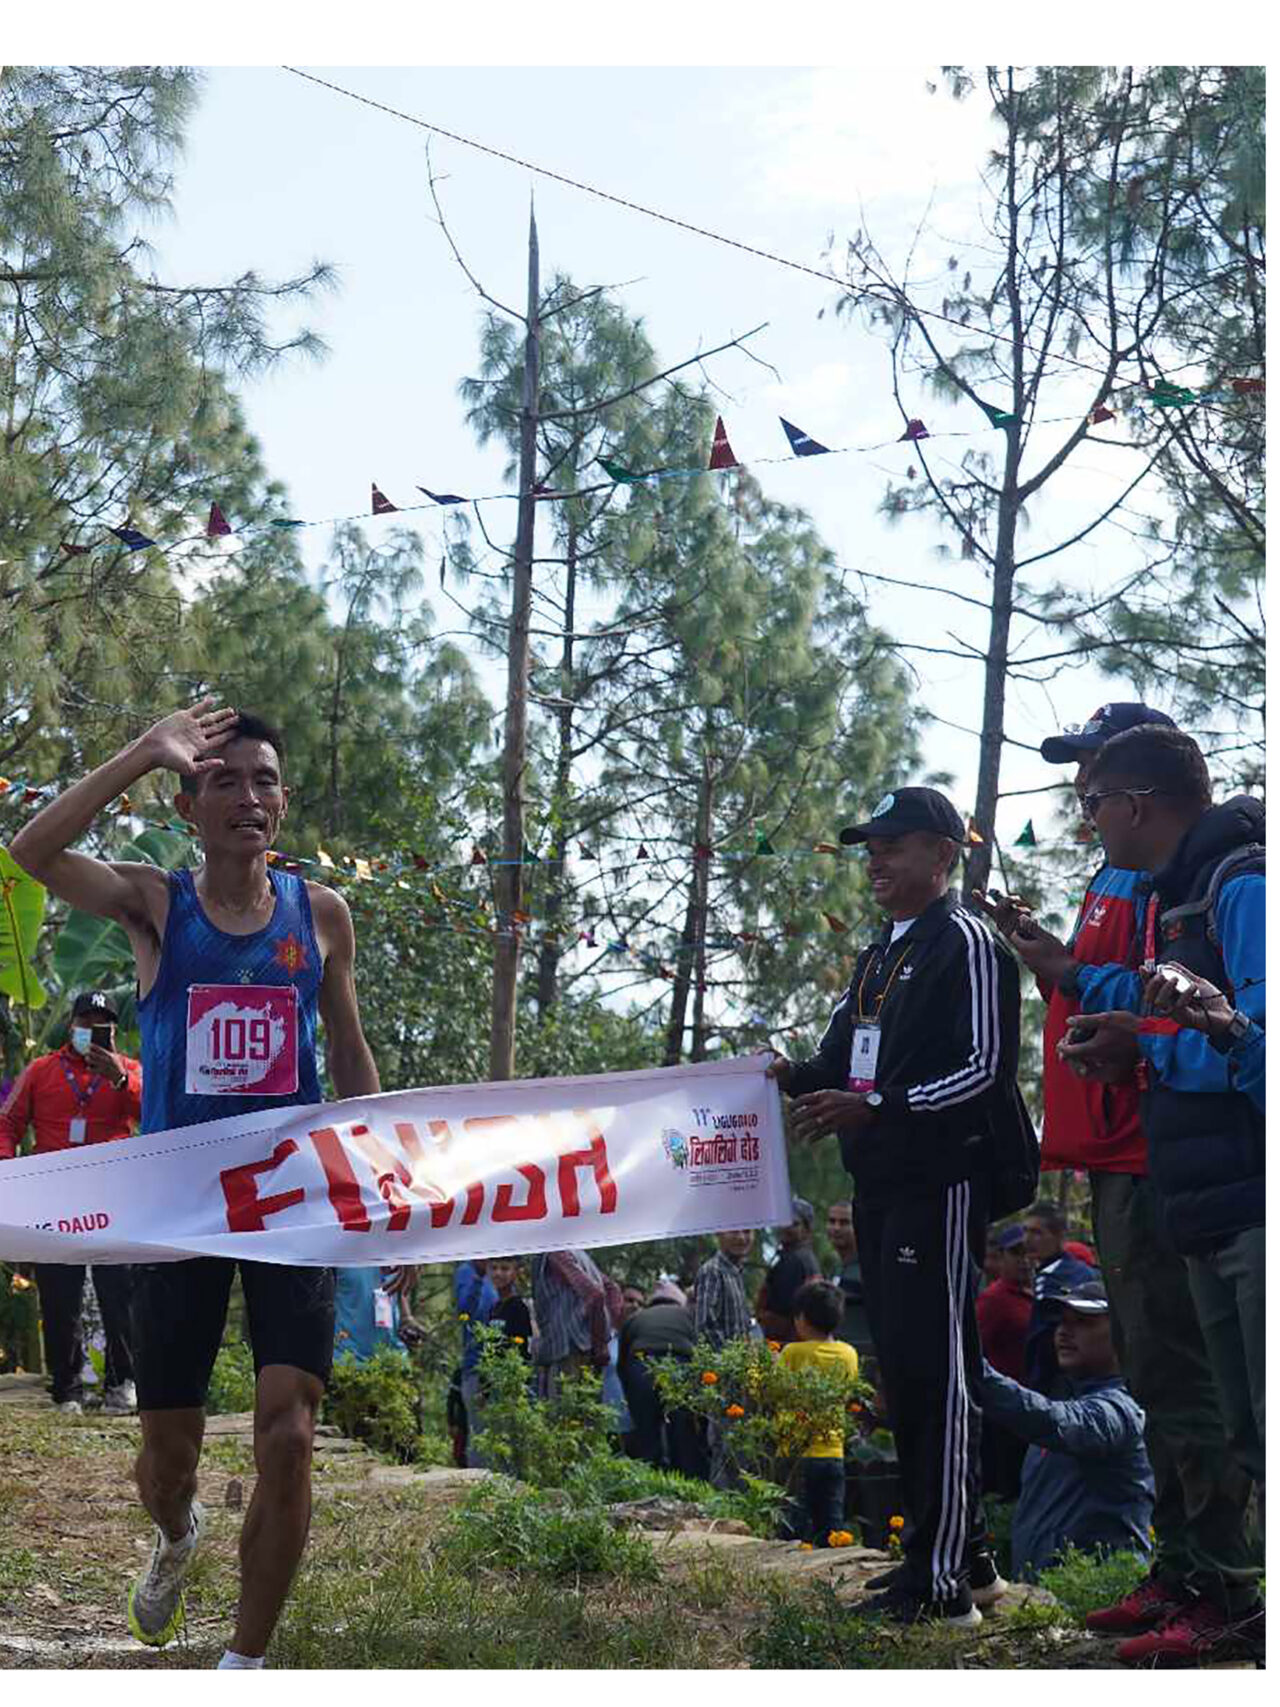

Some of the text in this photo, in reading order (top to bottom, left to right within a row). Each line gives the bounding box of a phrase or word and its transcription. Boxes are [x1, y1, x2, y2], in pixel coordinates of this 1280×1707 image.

[211, 1018, 271, 1061] 109
[692, 1107, 710, 1127] 11
[220, 1108, 621, 1232] FINISH
[58, 1212, 111, 1234] DAUD
